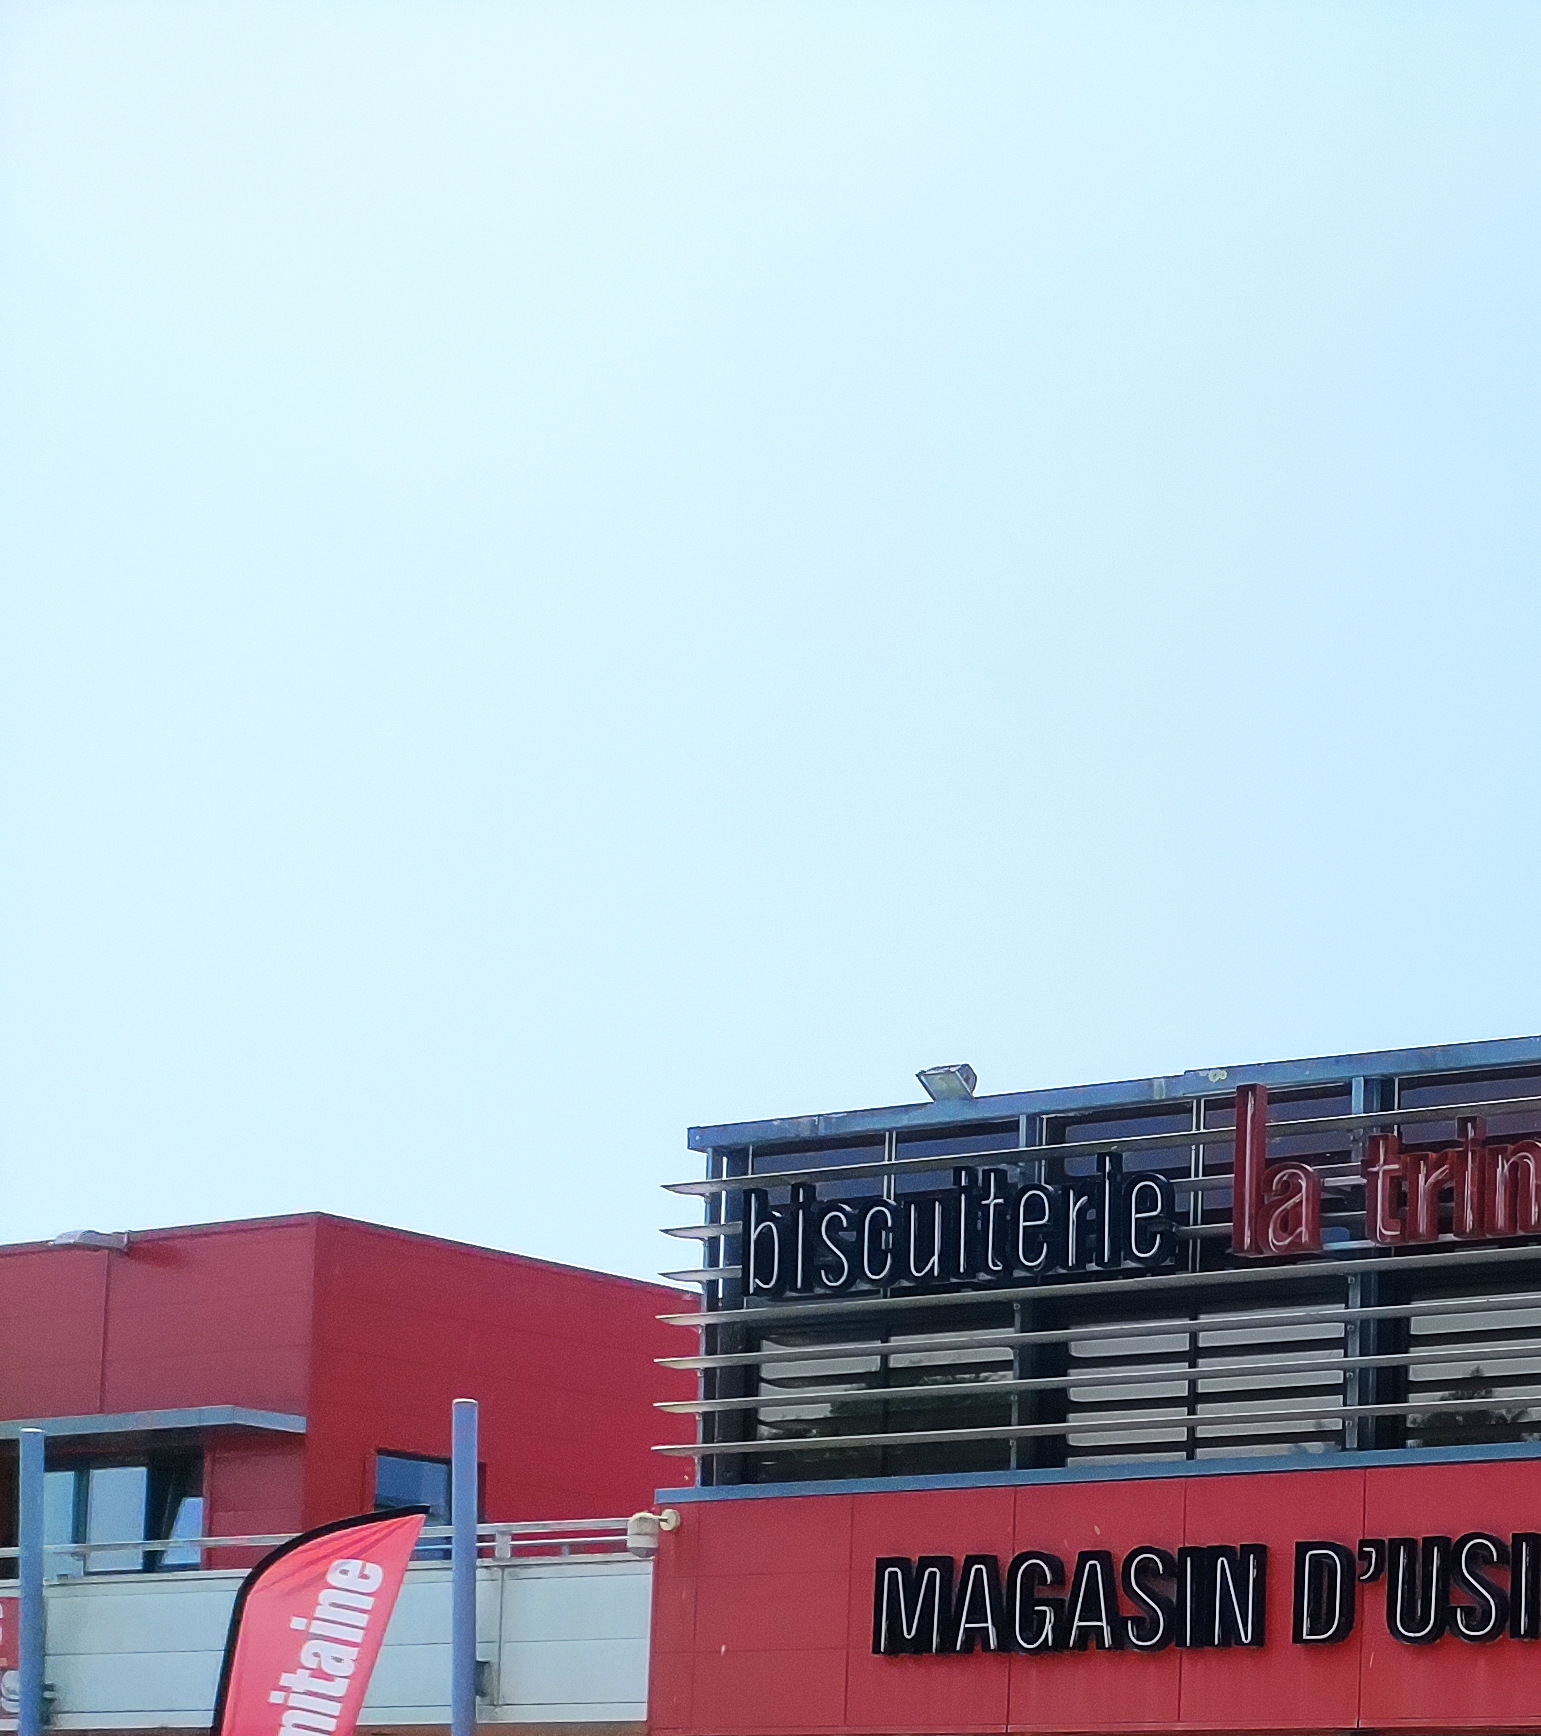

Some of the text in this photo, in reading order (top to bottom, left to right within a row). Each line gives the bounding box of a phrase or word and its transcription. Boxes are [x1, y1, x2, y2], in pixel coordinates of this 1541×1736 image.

[739, 1150, 1177, 1298] biscuiterie
[1233, 1083, 1322, 1256] la
[872, 1543, 1268, 1654] MAGASIN
